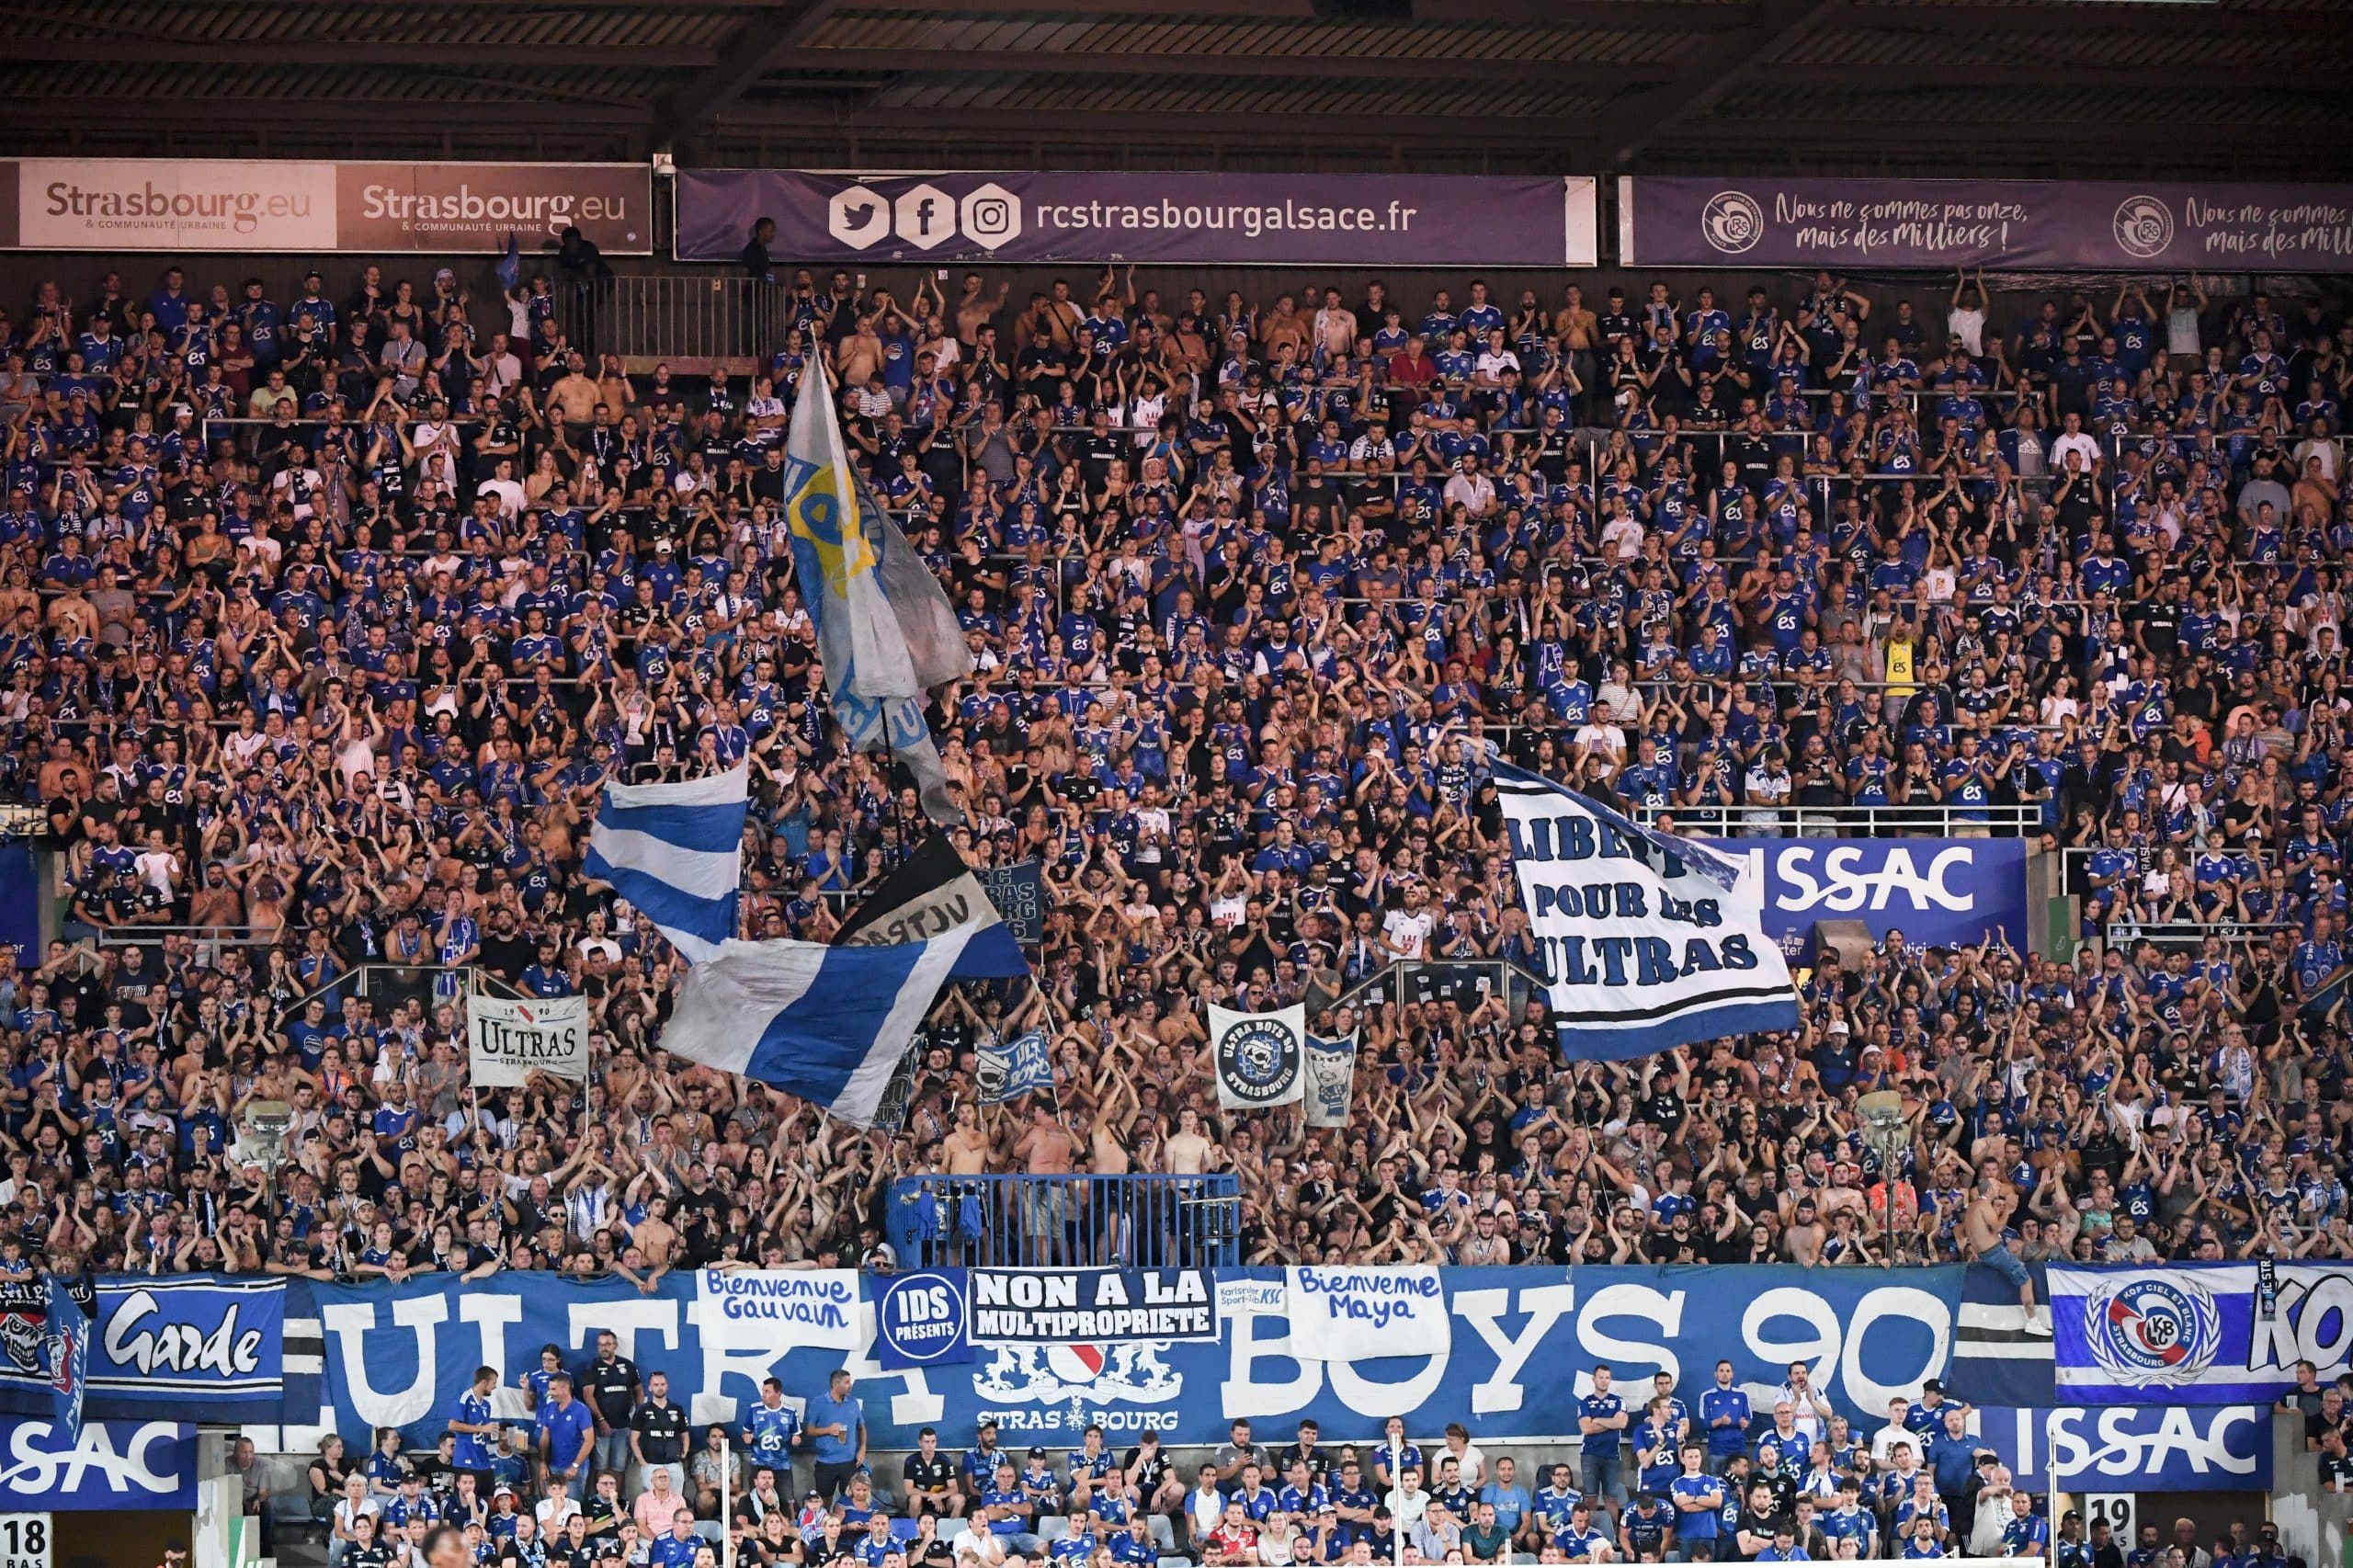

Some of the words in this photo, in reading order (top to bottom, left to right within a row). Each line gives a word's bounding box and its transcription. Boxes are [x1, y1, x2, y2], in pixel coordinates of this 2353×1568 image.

[46, 181, 311, 234] Strasbourg.eu
[363, 185, 625, 236] Strasbourg.eu
[1037, 199, 1417, 237] rcstrasbourgalsace.fr
[1776, 193, 1825, 223] Nous
[1831, 200, 1855, 219] ne
[1859, 201, 1938, 222] sommes
[1943, 203, 1973, 225] pas
[1977, 203, 2028, 223] onze,
[2186, 197, 2236, 228] Nous
[2240, 205, 2265, 222] ne
[2268, 205, 2347, 225] sommes
[85, 220, 94, 229] &
[98, 219, 176, 230] COMMUNAUTÉ
[180, 221, 226, 230] URBAINE
[402, 221, 410, 231] &
[415, 221, 492, 232] COMMUNAUTÉ
[495, 222, 541, 233] URBAINE
[1797, 224, 1848, 249] mais
[1854, 222, 1889, 256] des
[2206, 229, 2258, 254] mais
[2263, 227, 2296, 259] des
[2301, 226, 2353, 255] Mill
[1752, 335, 1768, 349] es
[2126, 335, 2142, 349] es
[188, 352, 205, 366] es
[1725, 507, 1742, 520] es
[1777, 615, 1795, 630] es
[1894, 661, 1906, 673] es
[752, 708, 769, 722] es
[2145, 707, 2162, 722] es
[1962, 786, 1981, 800] es
[1533, 882, 1648, 919] POUR
[1533, 934, 1757, 986] ULTRAS
[1222, 1023, 1253, 1058] ULTRA
[1256, 1020, 1286, 1039] BOYS
[1226, 1066, 1293, 1097] STRASBOURG
[897, 1286, 949, 1323] IDS
[977, 1273, 1077, 1309] NON
[1095, 1274, 1131, 1306] A
[1143, 1270, 1209, 1304] LA
[1260, 1289, 1282, 1305] KSC
[722, 1297, 849, 1328] Gauvain
[976, 1307, 1211, 1337] MULTIPROPRIETE
[1329, 1293, 1415, 1329] Maya
[2123, 1285, 2143, 1301] KOP
[2146, 1284, 2169, 1296] CIEL
[2171, 1294, 2185, 1306] ET
[2181, 1308, 2192, 1342] BLANC
[2246, 1274, 2353, 1372] KO
[104, 1290, 262, 1378] Garde
[895, 1320, 955, 1341] PRÉSENTS
[2112, 1324, 2165, 1367] STRASBOURG
[1742, 1286, 1952, 1419] 90
[977, 1410, 1061, 1431] STRAS
[1092, 1411, 1179, 1431] BOURG
[761, 1434, 781, 1450] es
[1656, 1451, 1674, 1465] es
[2090, 1497, 2130, 1531] 19
[3, 1520, 46, 1555] 18
